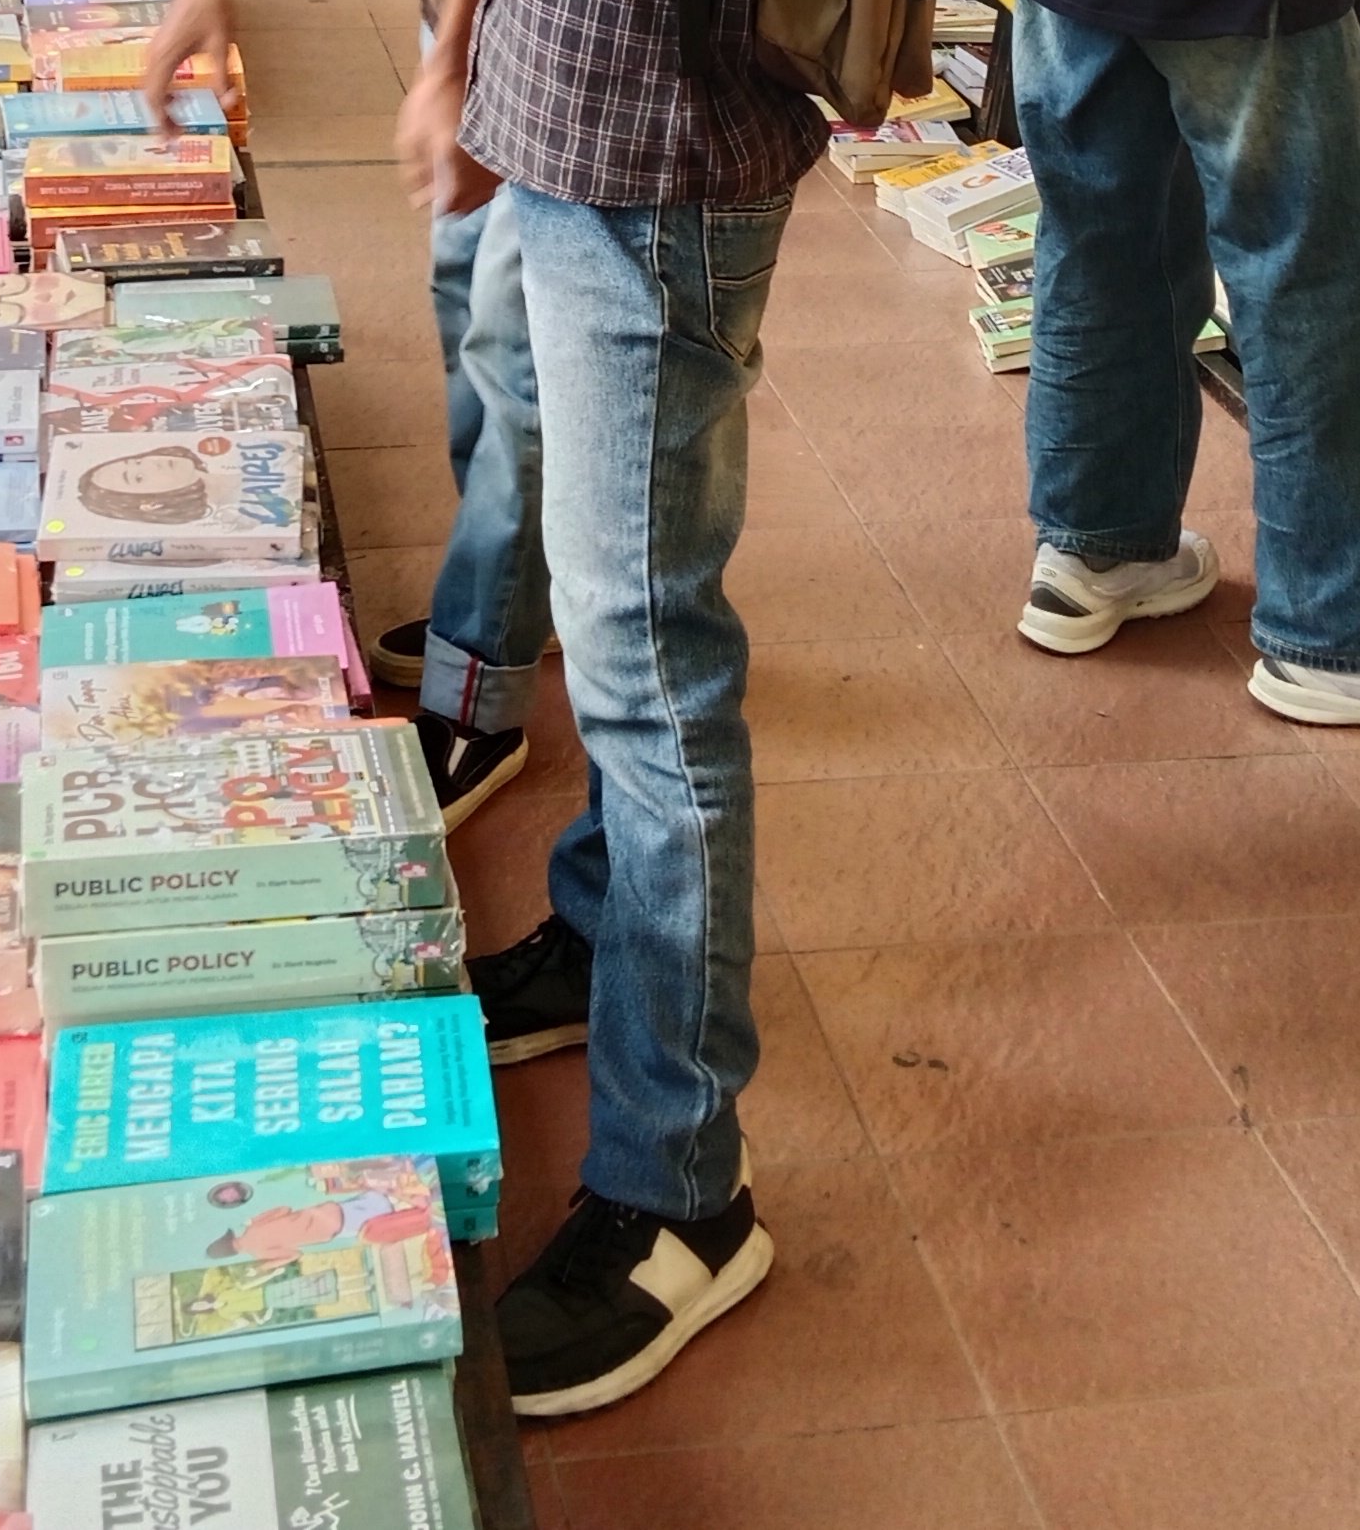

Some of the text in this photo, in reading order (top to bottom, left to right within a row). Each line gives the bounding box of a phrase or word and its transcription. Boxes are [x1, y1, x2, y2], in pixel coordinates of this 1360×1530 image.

[54, 876, 143, 898] PUBLIC
[72, 958, 160, 980] PUBLIC
[124, 1032, 176, 1163] MENGAPA
[191, 1059, 237, 1125] KITA
[254, 1037, 300, 1137] SERING
[317, 1024, 364, 1124] SALAH
[378, 1021, 428, 1130] PAHAM?
[390, 1378, 418, 1460] MAXWELL
[100, 1458, 144, 1530] THE
[186, 1446, 232, 1524] YOU
